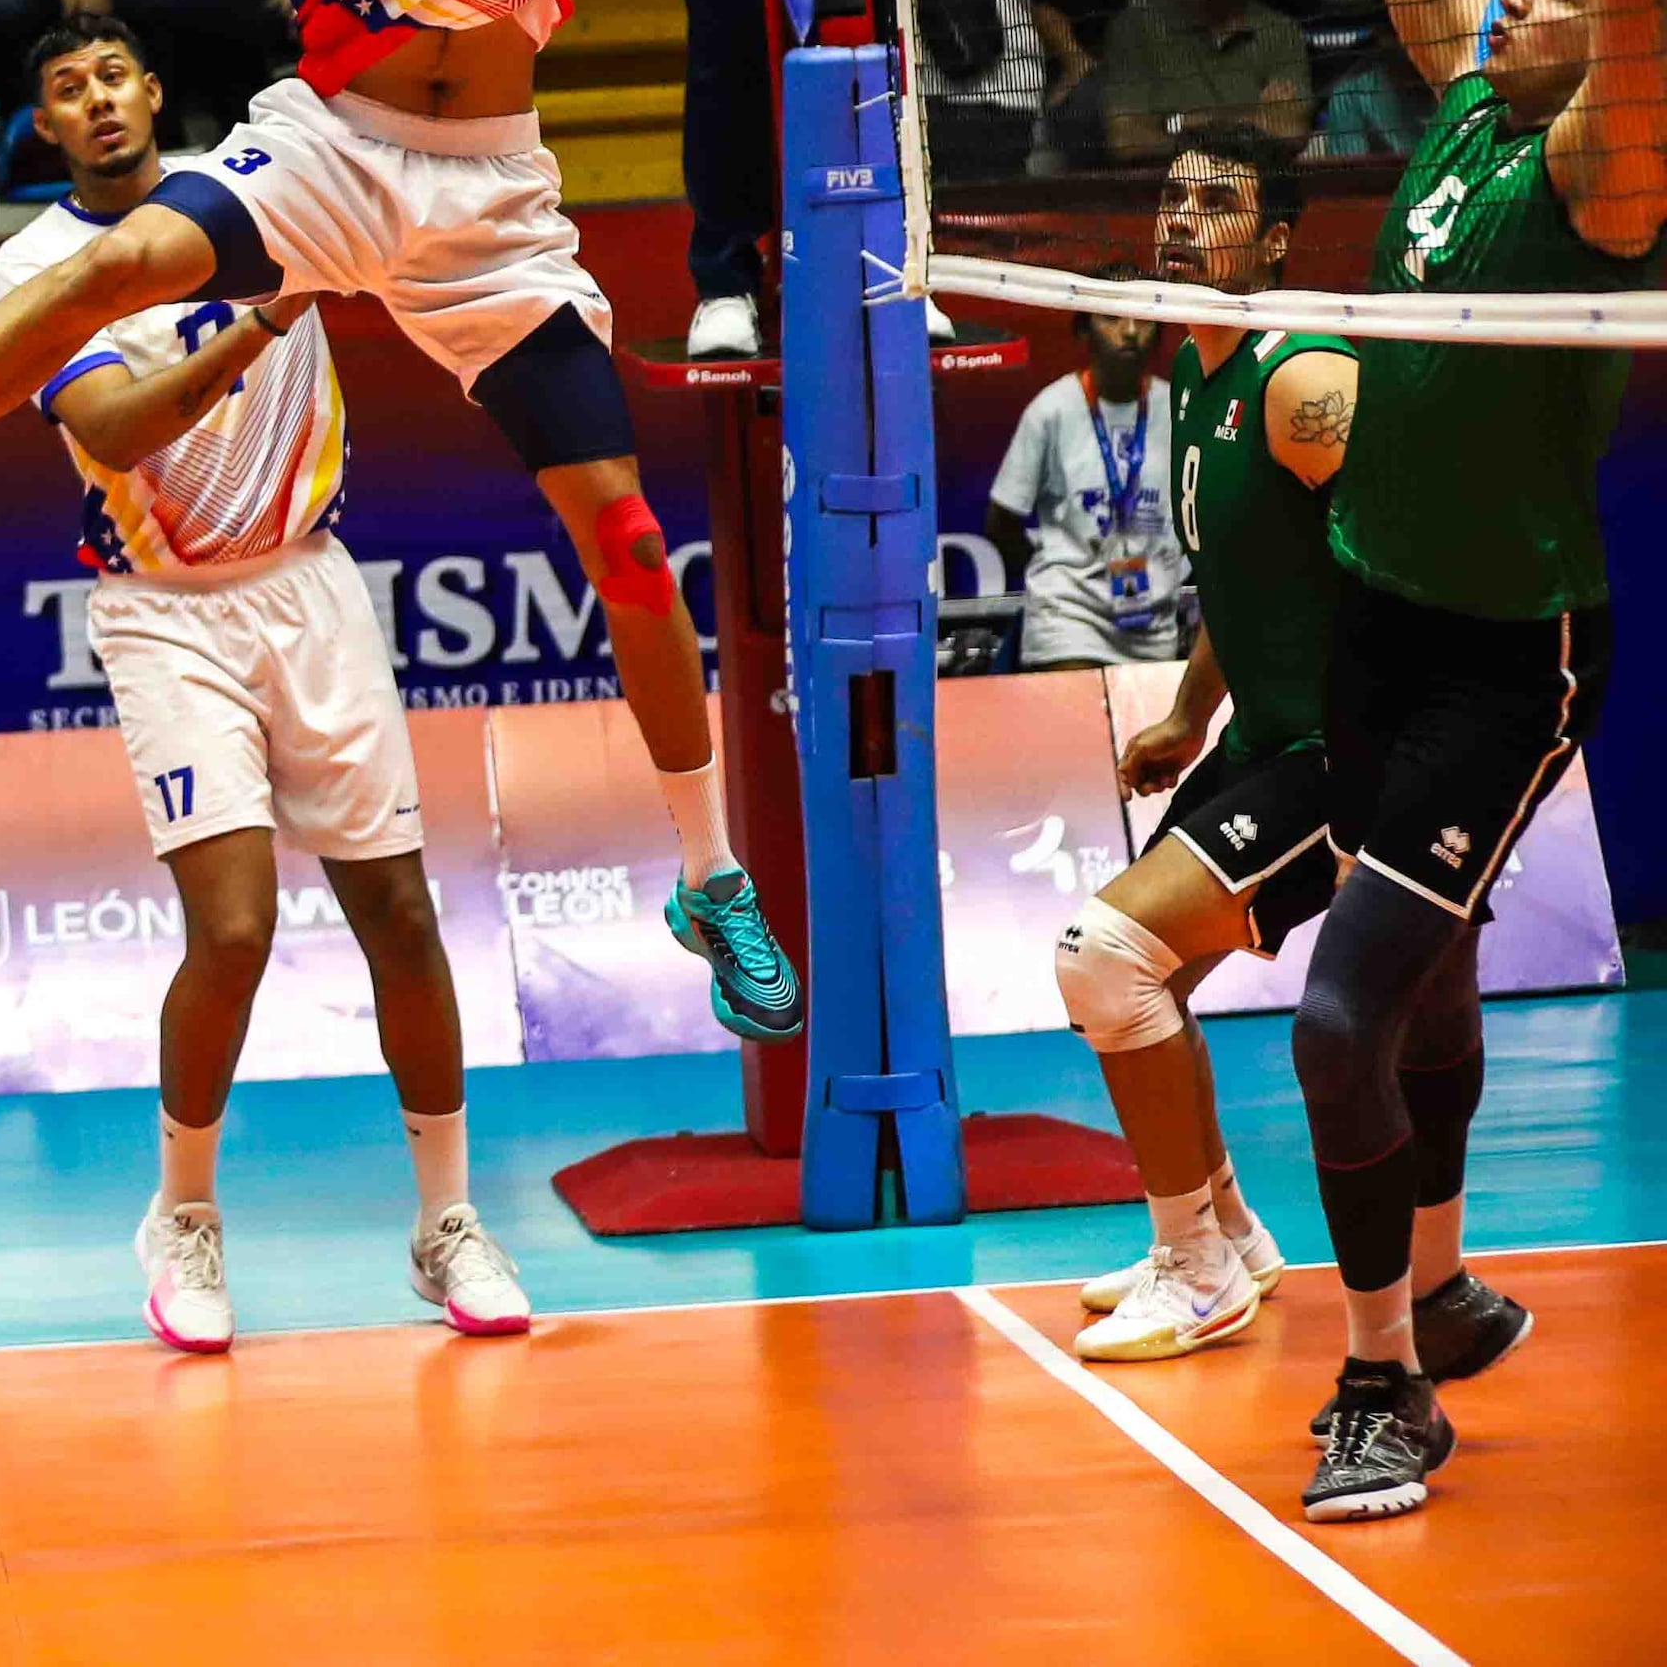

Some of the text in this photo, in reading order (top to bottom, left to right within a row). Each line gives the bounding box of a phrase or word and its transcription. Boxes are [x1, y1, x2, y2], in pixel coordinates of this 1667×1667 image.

[223, 147, 272, 175] 3
[826, 168, 873, 187] FIVB
[1214, 424, 1238, 442] MEX
[1181, 445, 1201, 551] 8
[154, 766, 195, 823] 17
[1221, 823, 1245, 853] errea
[23, 888, 181, 945] LEÓN
